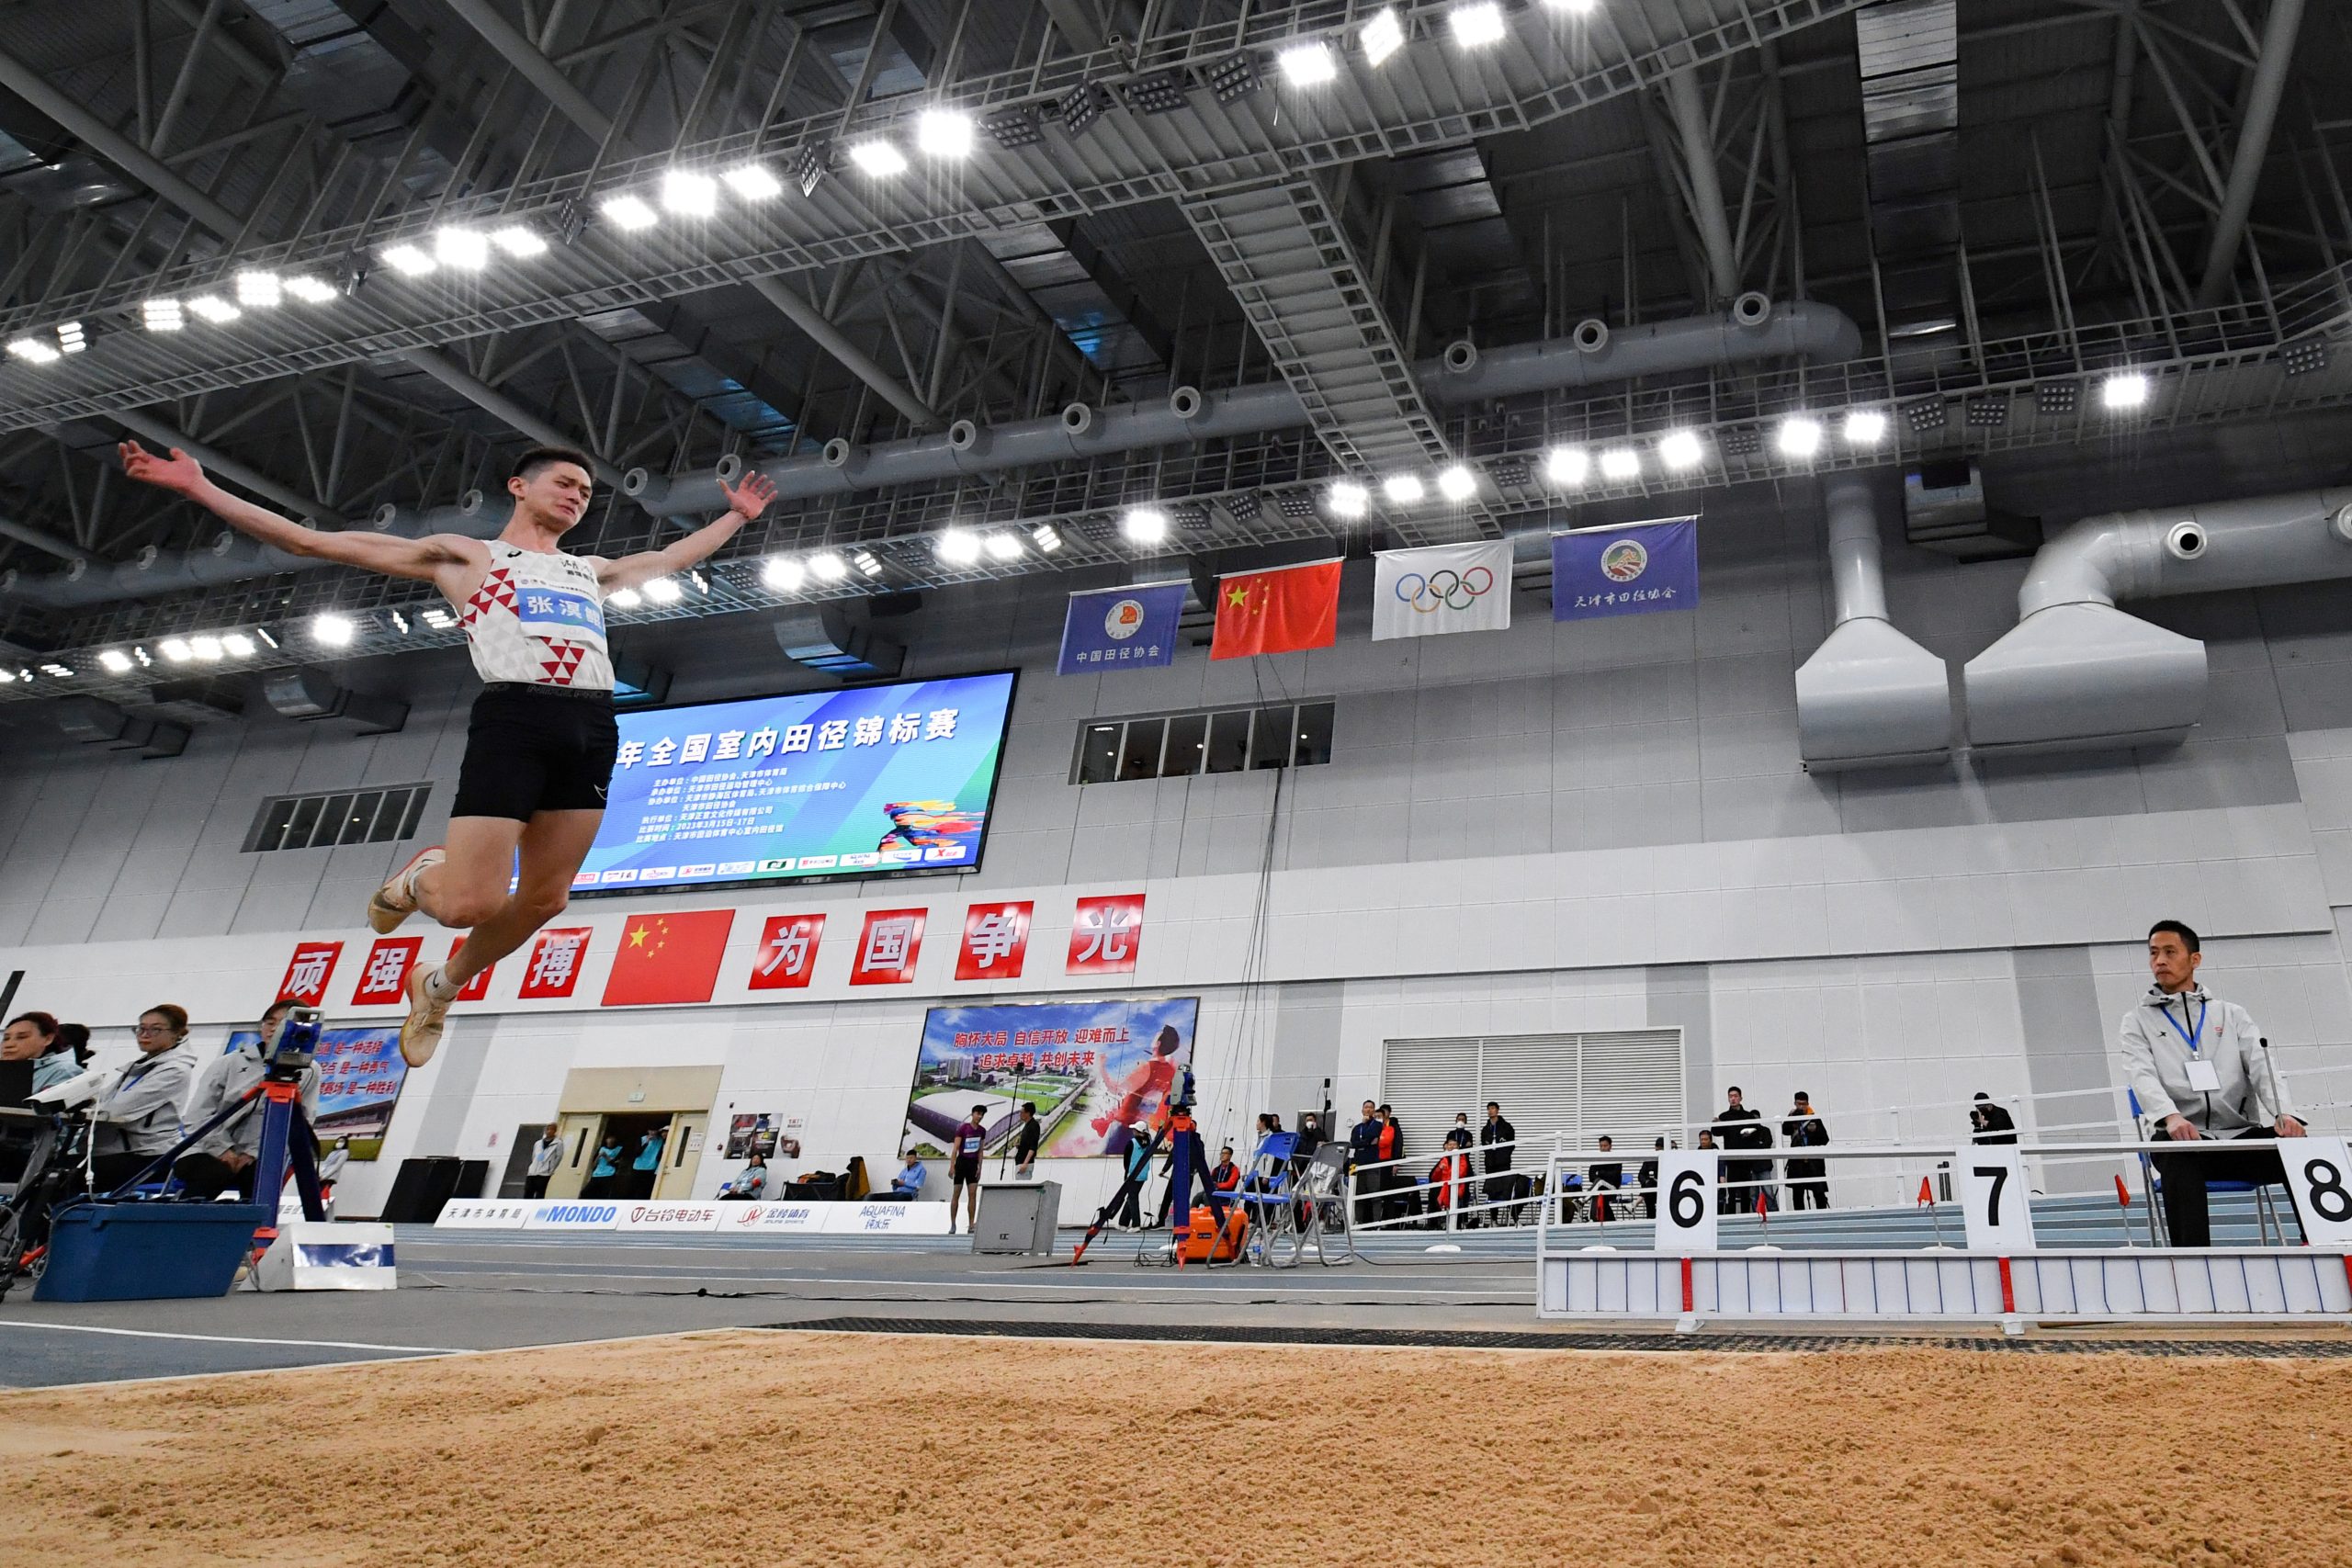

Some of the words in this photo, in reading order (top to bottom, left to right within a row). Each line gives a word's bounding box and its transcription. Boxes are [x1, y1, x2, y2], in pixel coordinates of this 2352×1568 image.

[1575, 587, 1676, 607] 天津市田径协会
[1077, 645, 1159, 662] 中国田径协会
[616, 708, 959, 770] 年全国室内田径锦标赛
[762, 908, 1129, 976] 为国争光
[954, 1031, 1008, 1048] 胸怀大局
[1013, 1029, 1069, 1046] 自信开放
[1074, 1027, 1129, 1044] 迎难而上
[979, 1052, 1035, 1069] 追求卓越
[1040, 1050, 1095, 1066] 共创未来
[1668, 1170, 1704, 1228] 6
[1973, 1167, 2008, 1226] 7
[2304, 1158, 2352, 1222] 8
[447, 1207, 523, 1219] 天津市体育局
[546, 1205, 616, 1223] MONDO
[645, 1209, 716, 1222] 台铃电动车
[859, 1205, 906, 1218] AQUAFINA
